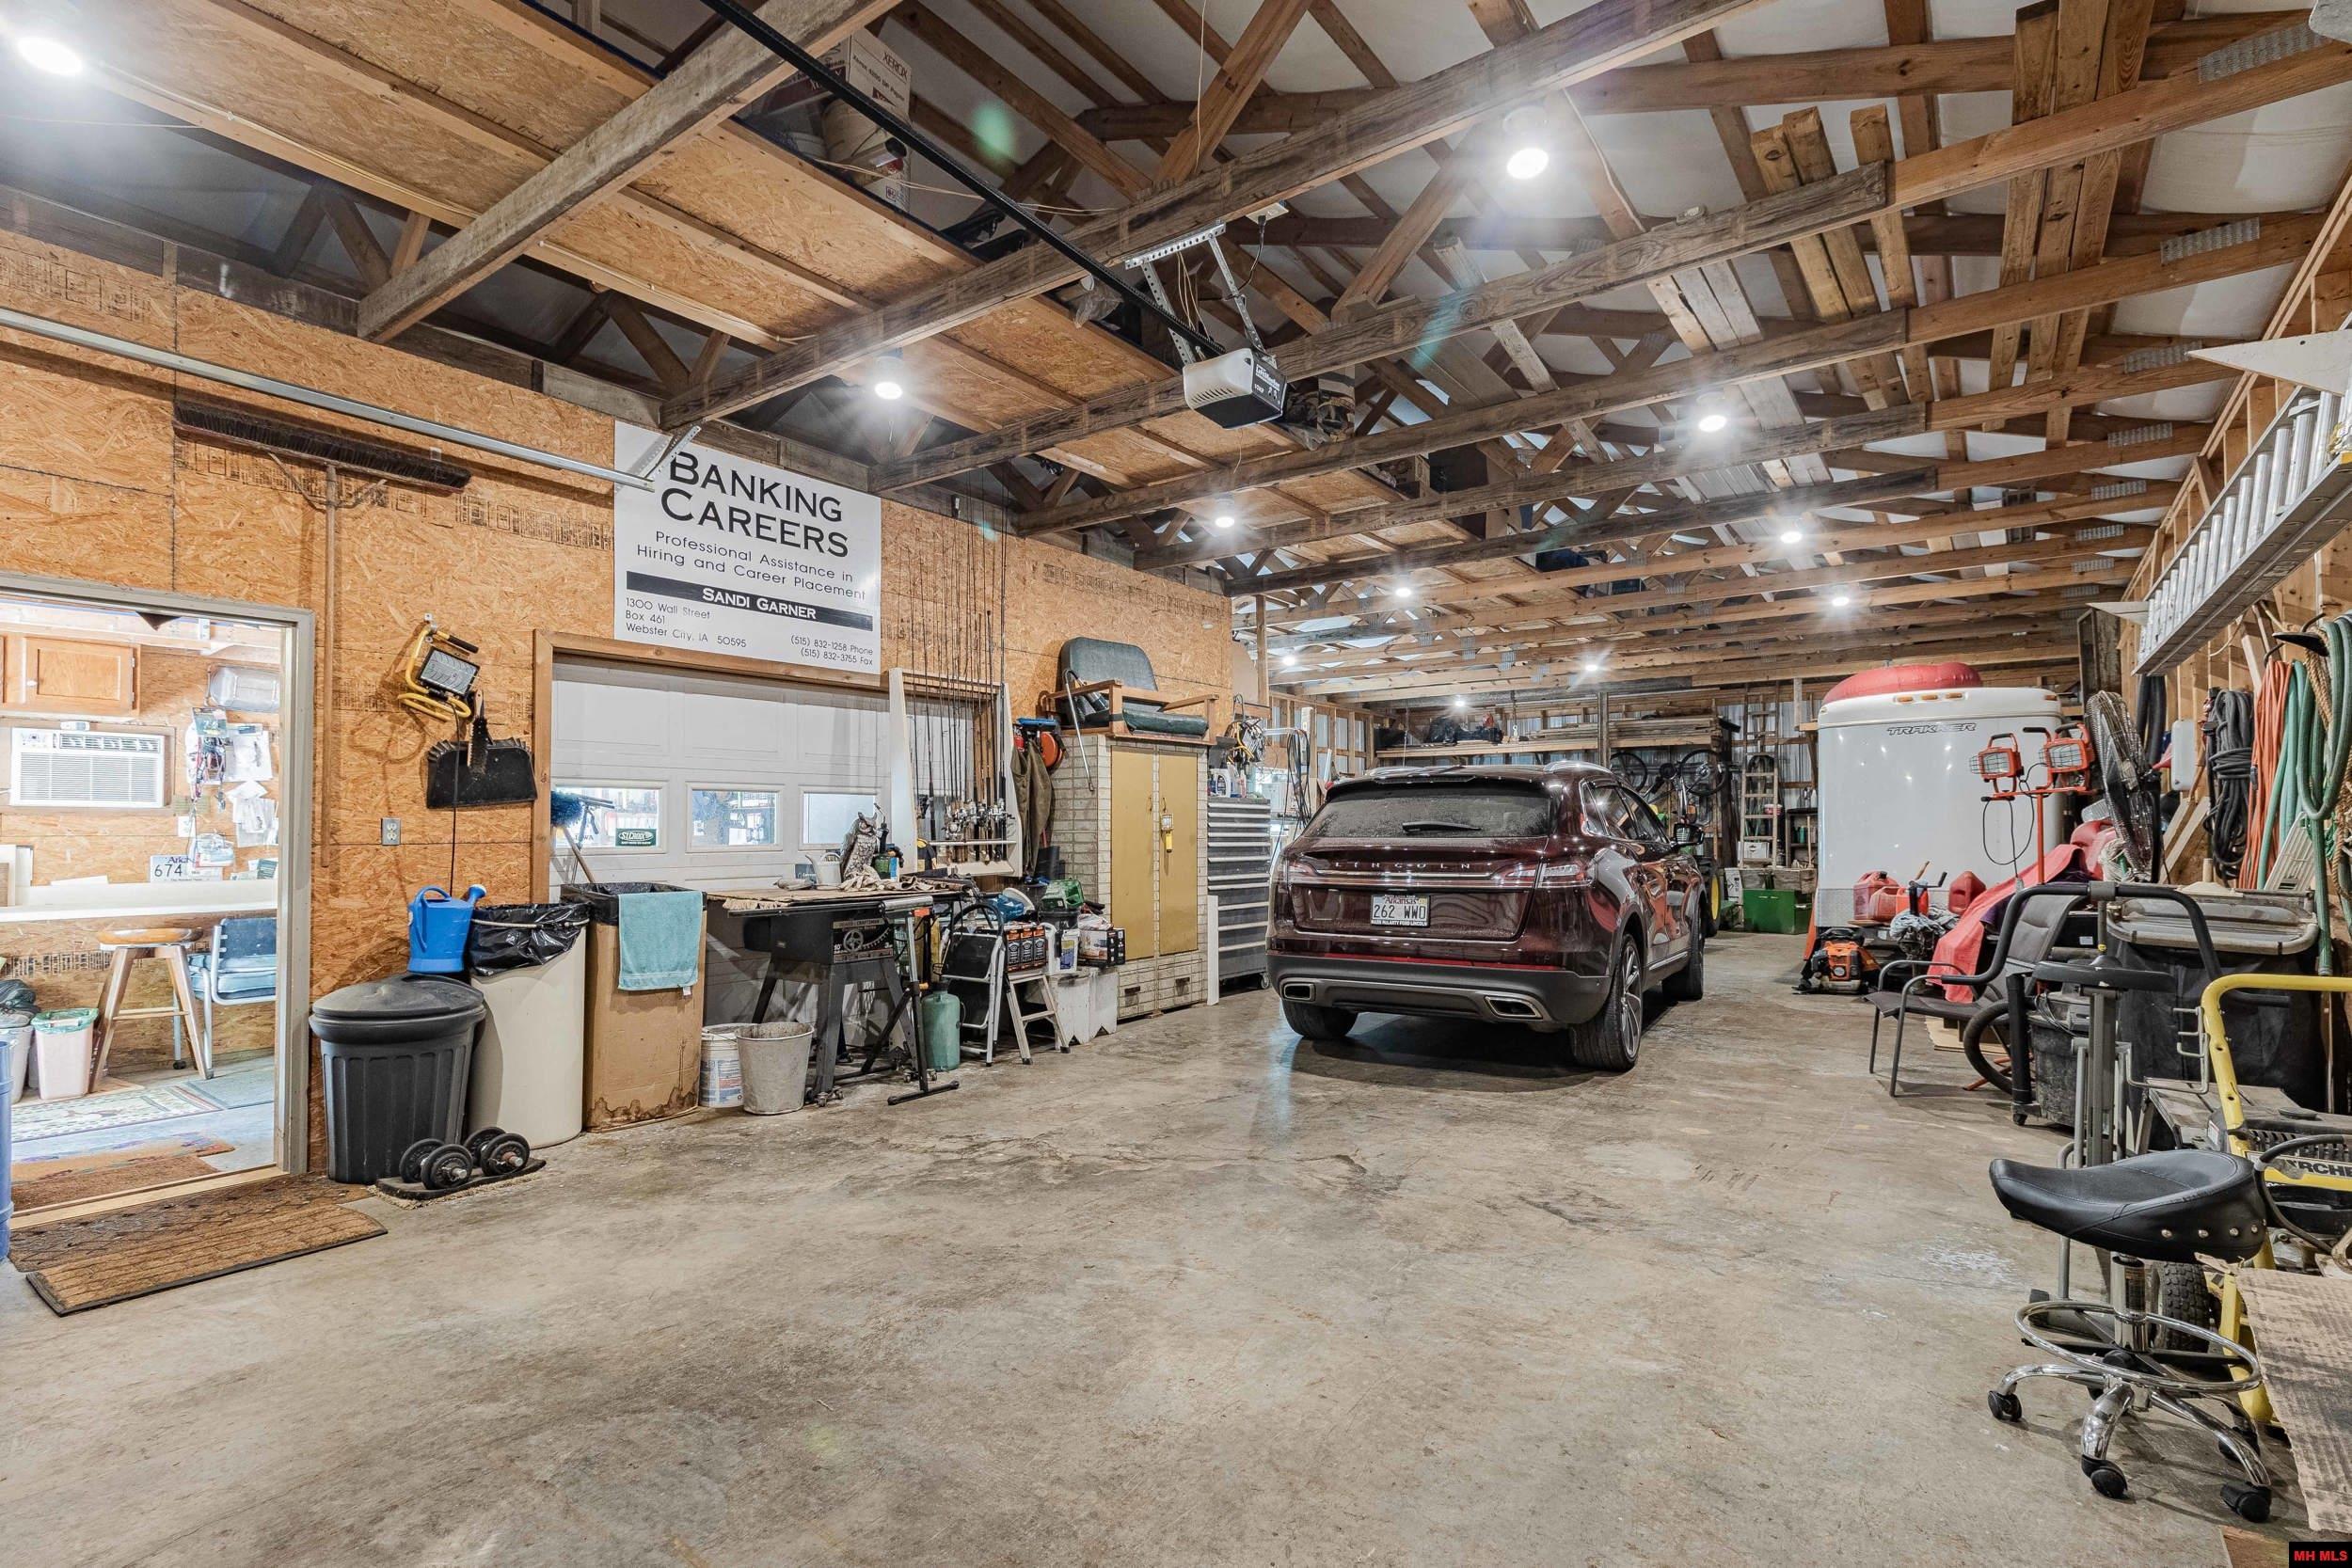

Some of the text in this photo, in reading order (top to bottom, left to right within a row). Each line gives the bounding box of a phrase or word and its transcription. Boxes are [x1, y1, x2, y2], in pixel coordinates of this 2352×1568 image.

[882, 52, 908, 81] XEROX
[670, 451, 842, 522] BANKING
[661, 487, 849, 558] CAREERS
[656, 531, 853, 582] Professional Assistance in
[637, 545, 866, 600] Hiring and Career Placement
[626, 597, 710, 619] 1300 Wall Street
[702, 587, 817, 620] SANDI GARNER
[626, 610, 665, 625] Box 461
[626, 623, 668, 637] Webster
[717, 635, 747, 647] 50595
[790, 635, 873, 655] (515) 832-1258 Phone
[801, 647, 820, 658] (515)
[860, 657, 873, 665] Fax
[154, 863, 183, 878] 674
[1374, 905, 1395, 919] 262
